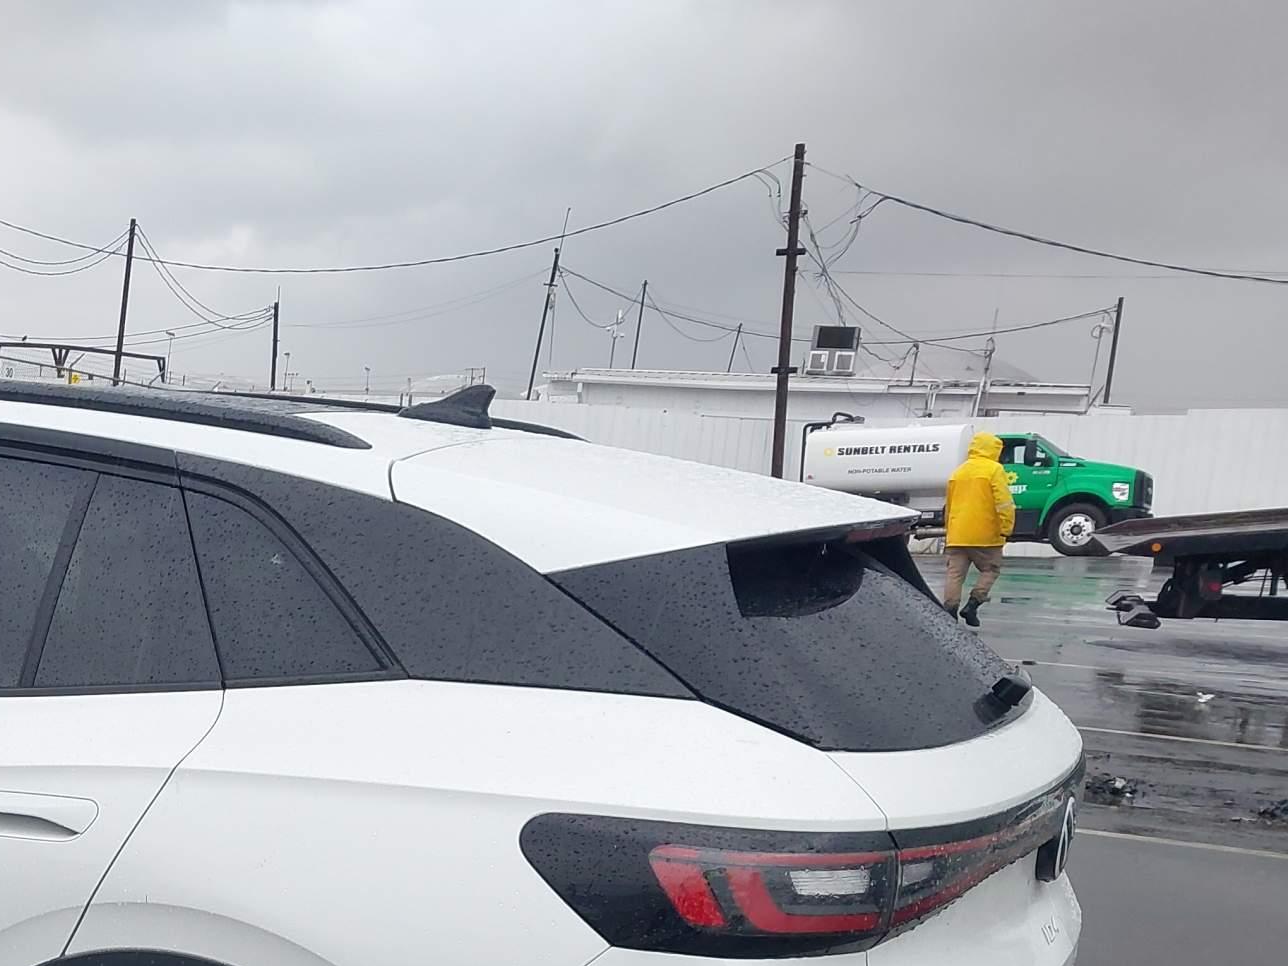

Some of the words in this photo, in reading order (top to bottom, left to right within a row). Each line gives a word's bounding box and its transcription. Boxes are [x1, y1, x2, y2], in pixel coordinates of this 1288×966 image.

[5, 368, 14, 378] 30
[837, 446, 887, 456] SUNBELT
[889, 443, 940, 454] RENTALS
